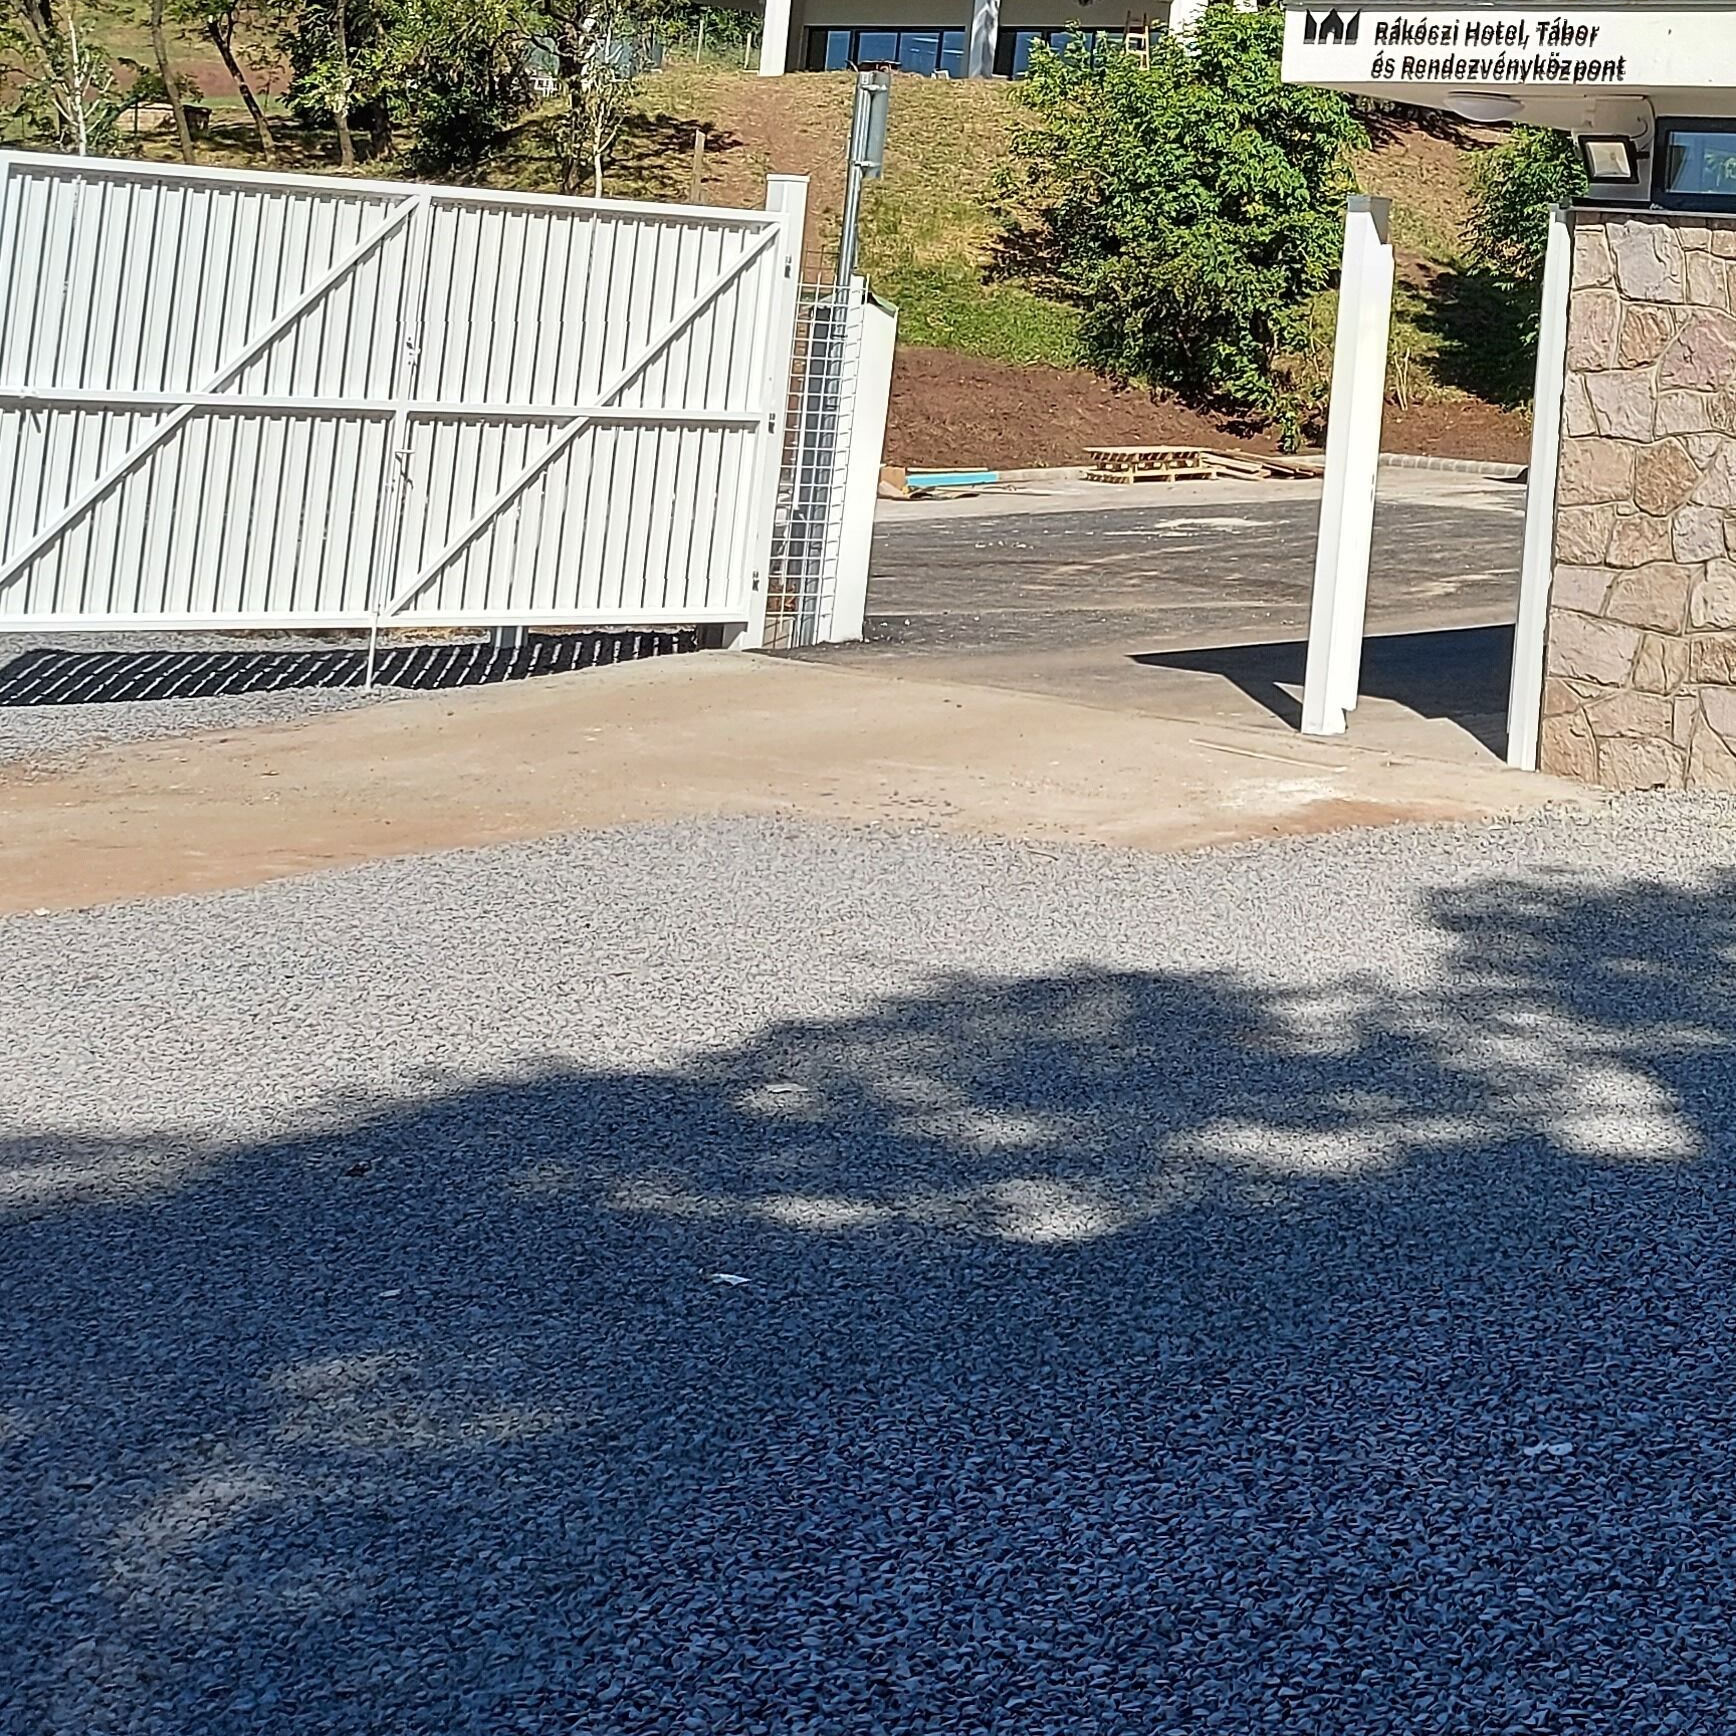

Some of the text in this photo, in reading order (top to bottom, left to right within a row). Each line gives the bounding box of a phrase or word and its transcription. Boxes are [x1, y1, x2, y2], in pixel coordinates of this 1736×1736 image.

[1374, 16, 1599, 49] Rákóczi Hotel, Tábor
[1371, 50, 1626, 84] és Rendezvényközpont
